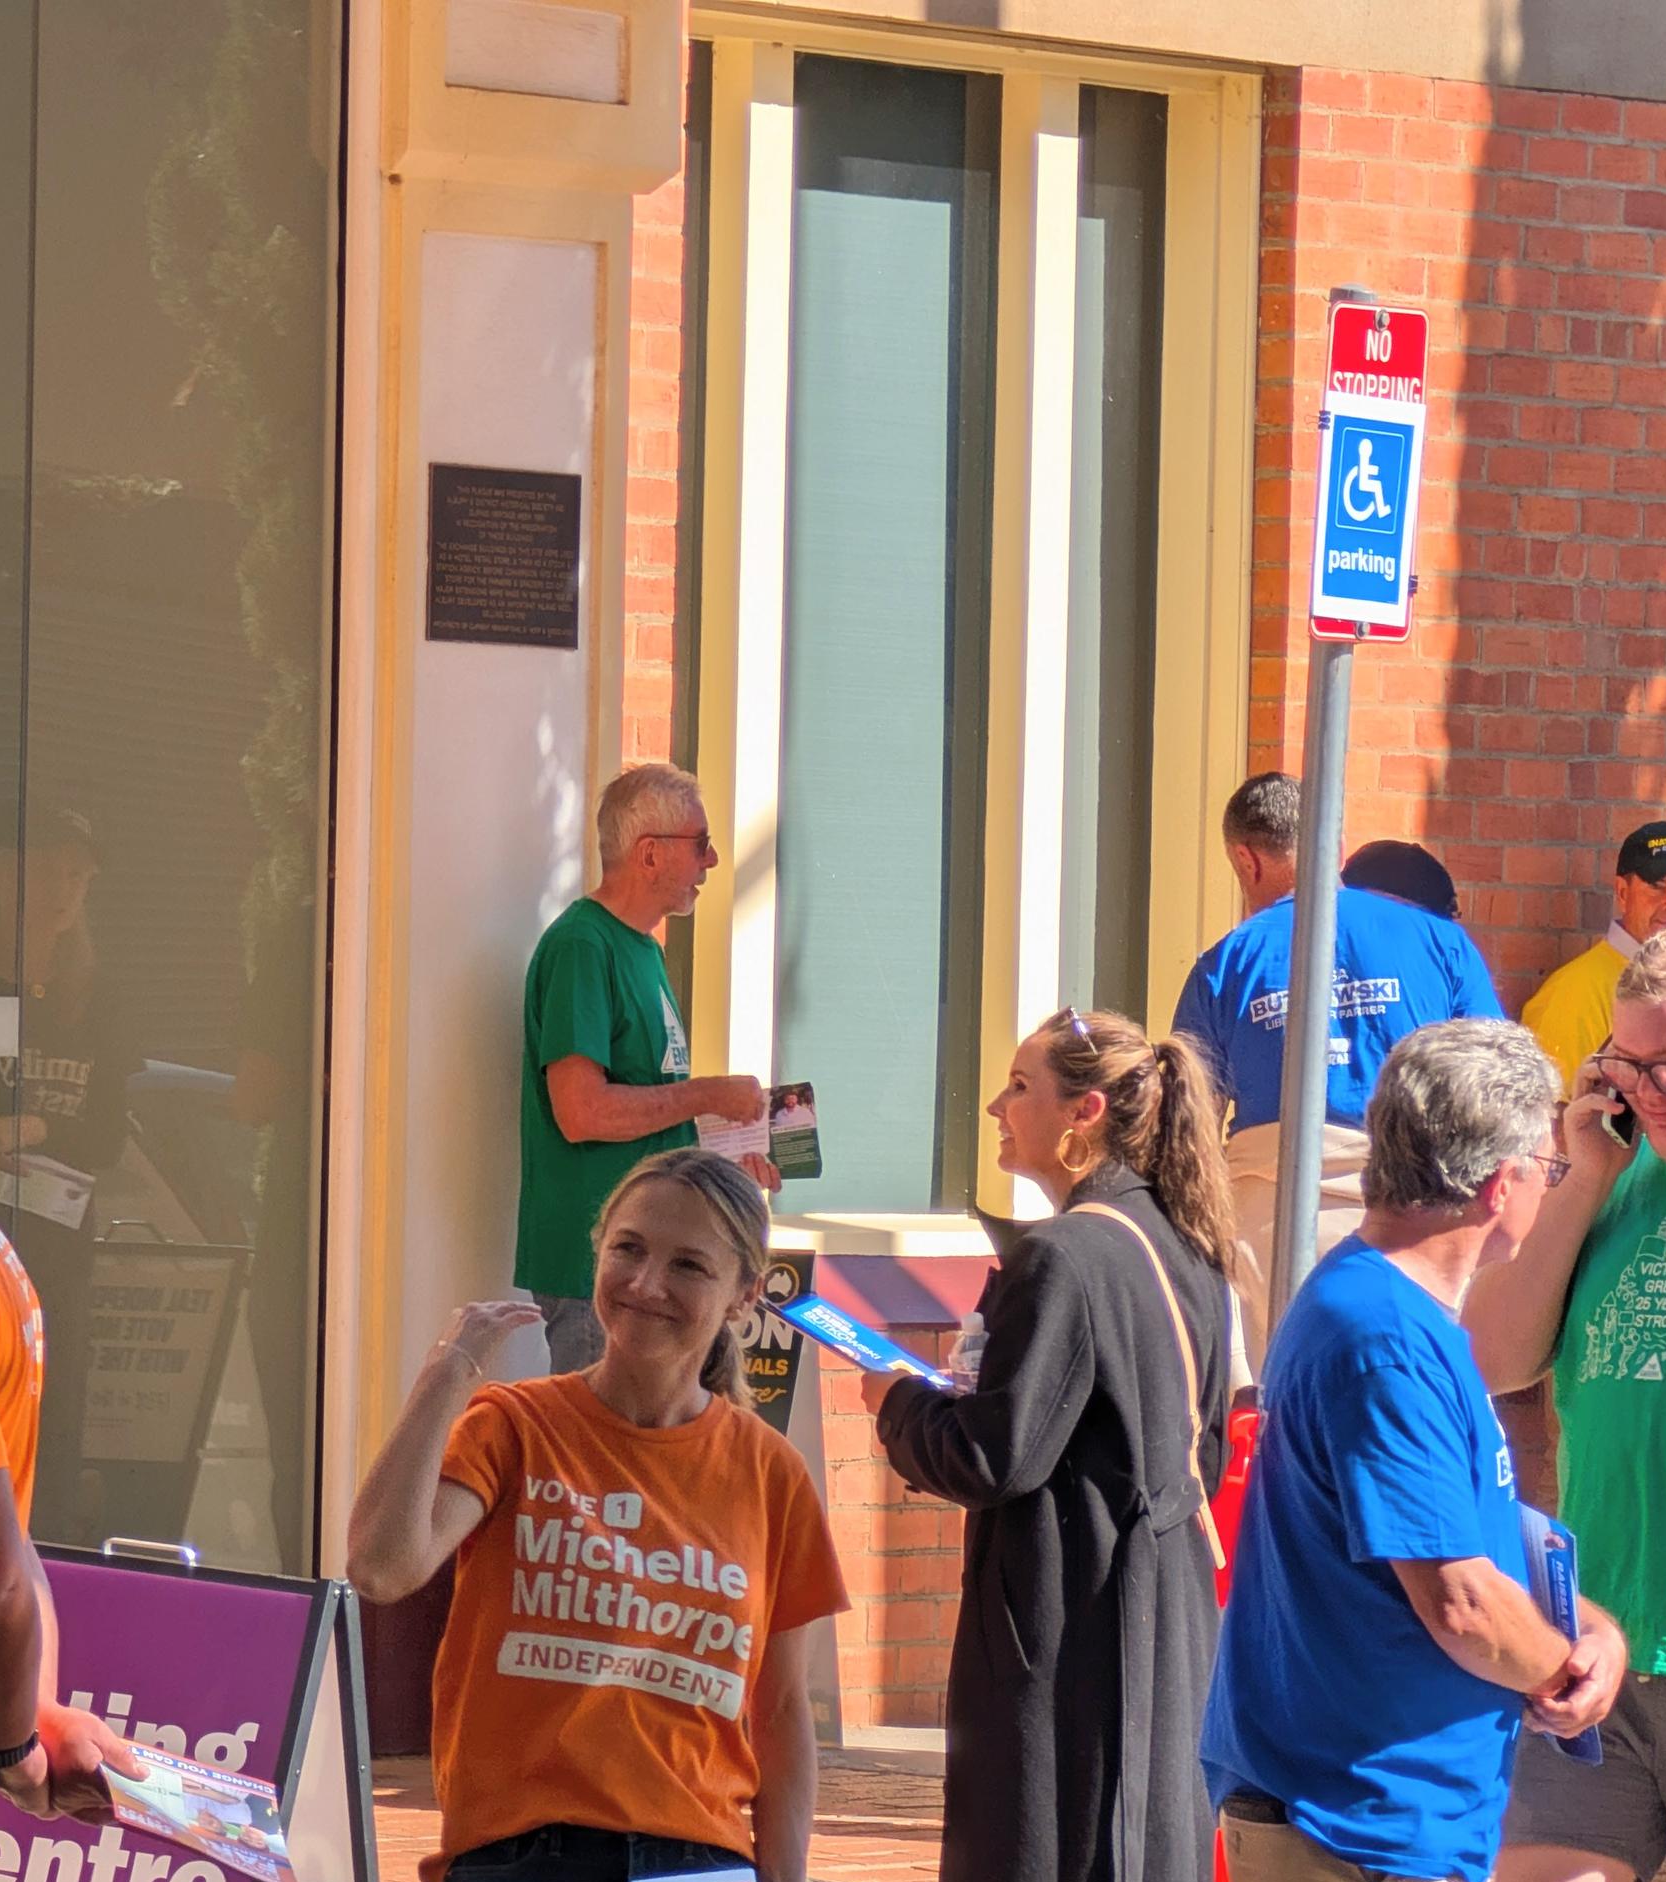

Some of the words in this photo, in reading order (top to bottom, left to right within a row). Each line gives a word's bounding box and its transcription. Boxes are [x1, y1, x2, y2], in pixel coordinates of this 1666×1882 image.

[1366, 328, 1391, 363] NO
[1333, 370, 1421, 404] STOPPING
[1328, 547, 1396, 582] parking
[1635, 1297, 1649, 1310] 25
[526, 1475, 598, 1518] VOTE
[617, 1500, 628, 1519] 1
[515, 1514, 749, 1600] Michelle
[512, 1569, 754, 1662] Milthorpe
[515, 1643, 732, 1703] INDEPENDENT
[142, 1749, 176, 1768] CAN
[177, 1760, 210, 1778] YOU
[212, 1769, 275, 1795] CHANGE
